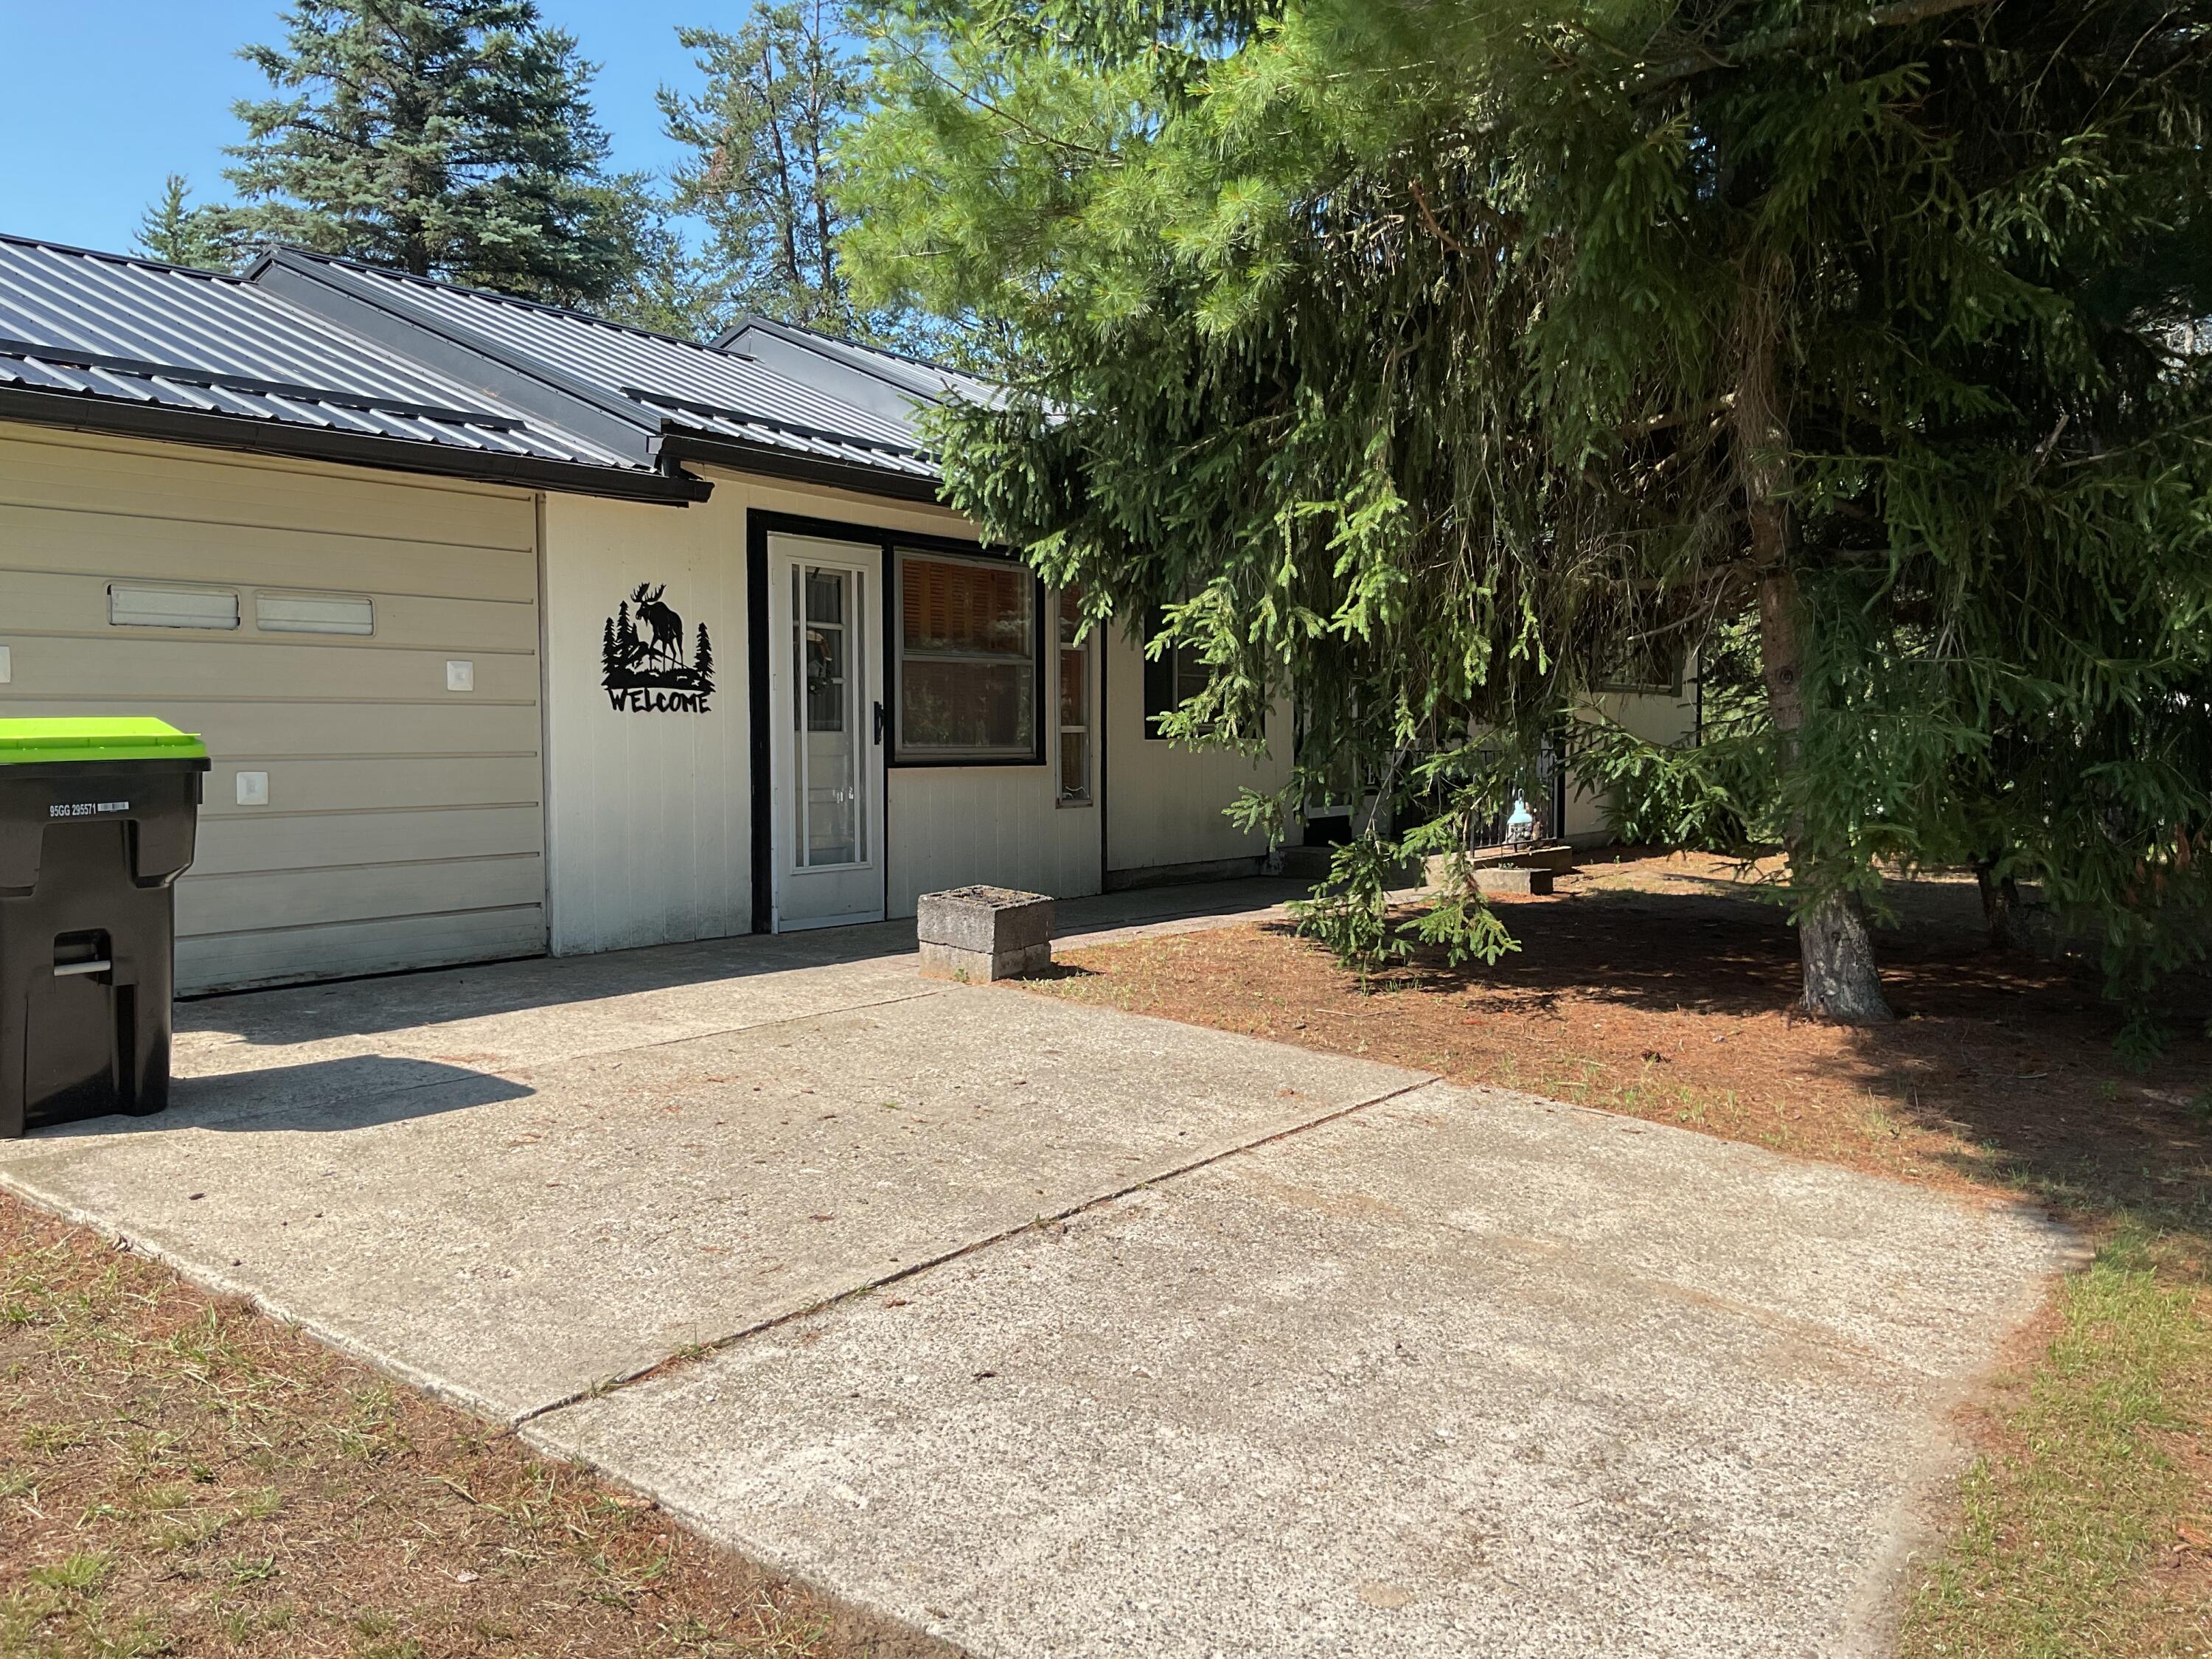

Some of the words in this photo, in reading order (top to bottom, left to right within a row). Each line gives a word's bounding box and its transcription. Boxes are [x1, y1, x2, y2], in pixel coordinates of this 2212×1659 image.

[608, 687, 712, 713] WELCOME
[49, 804, 70, 817] 95GG
[72, 803, 96, 815] 295571
